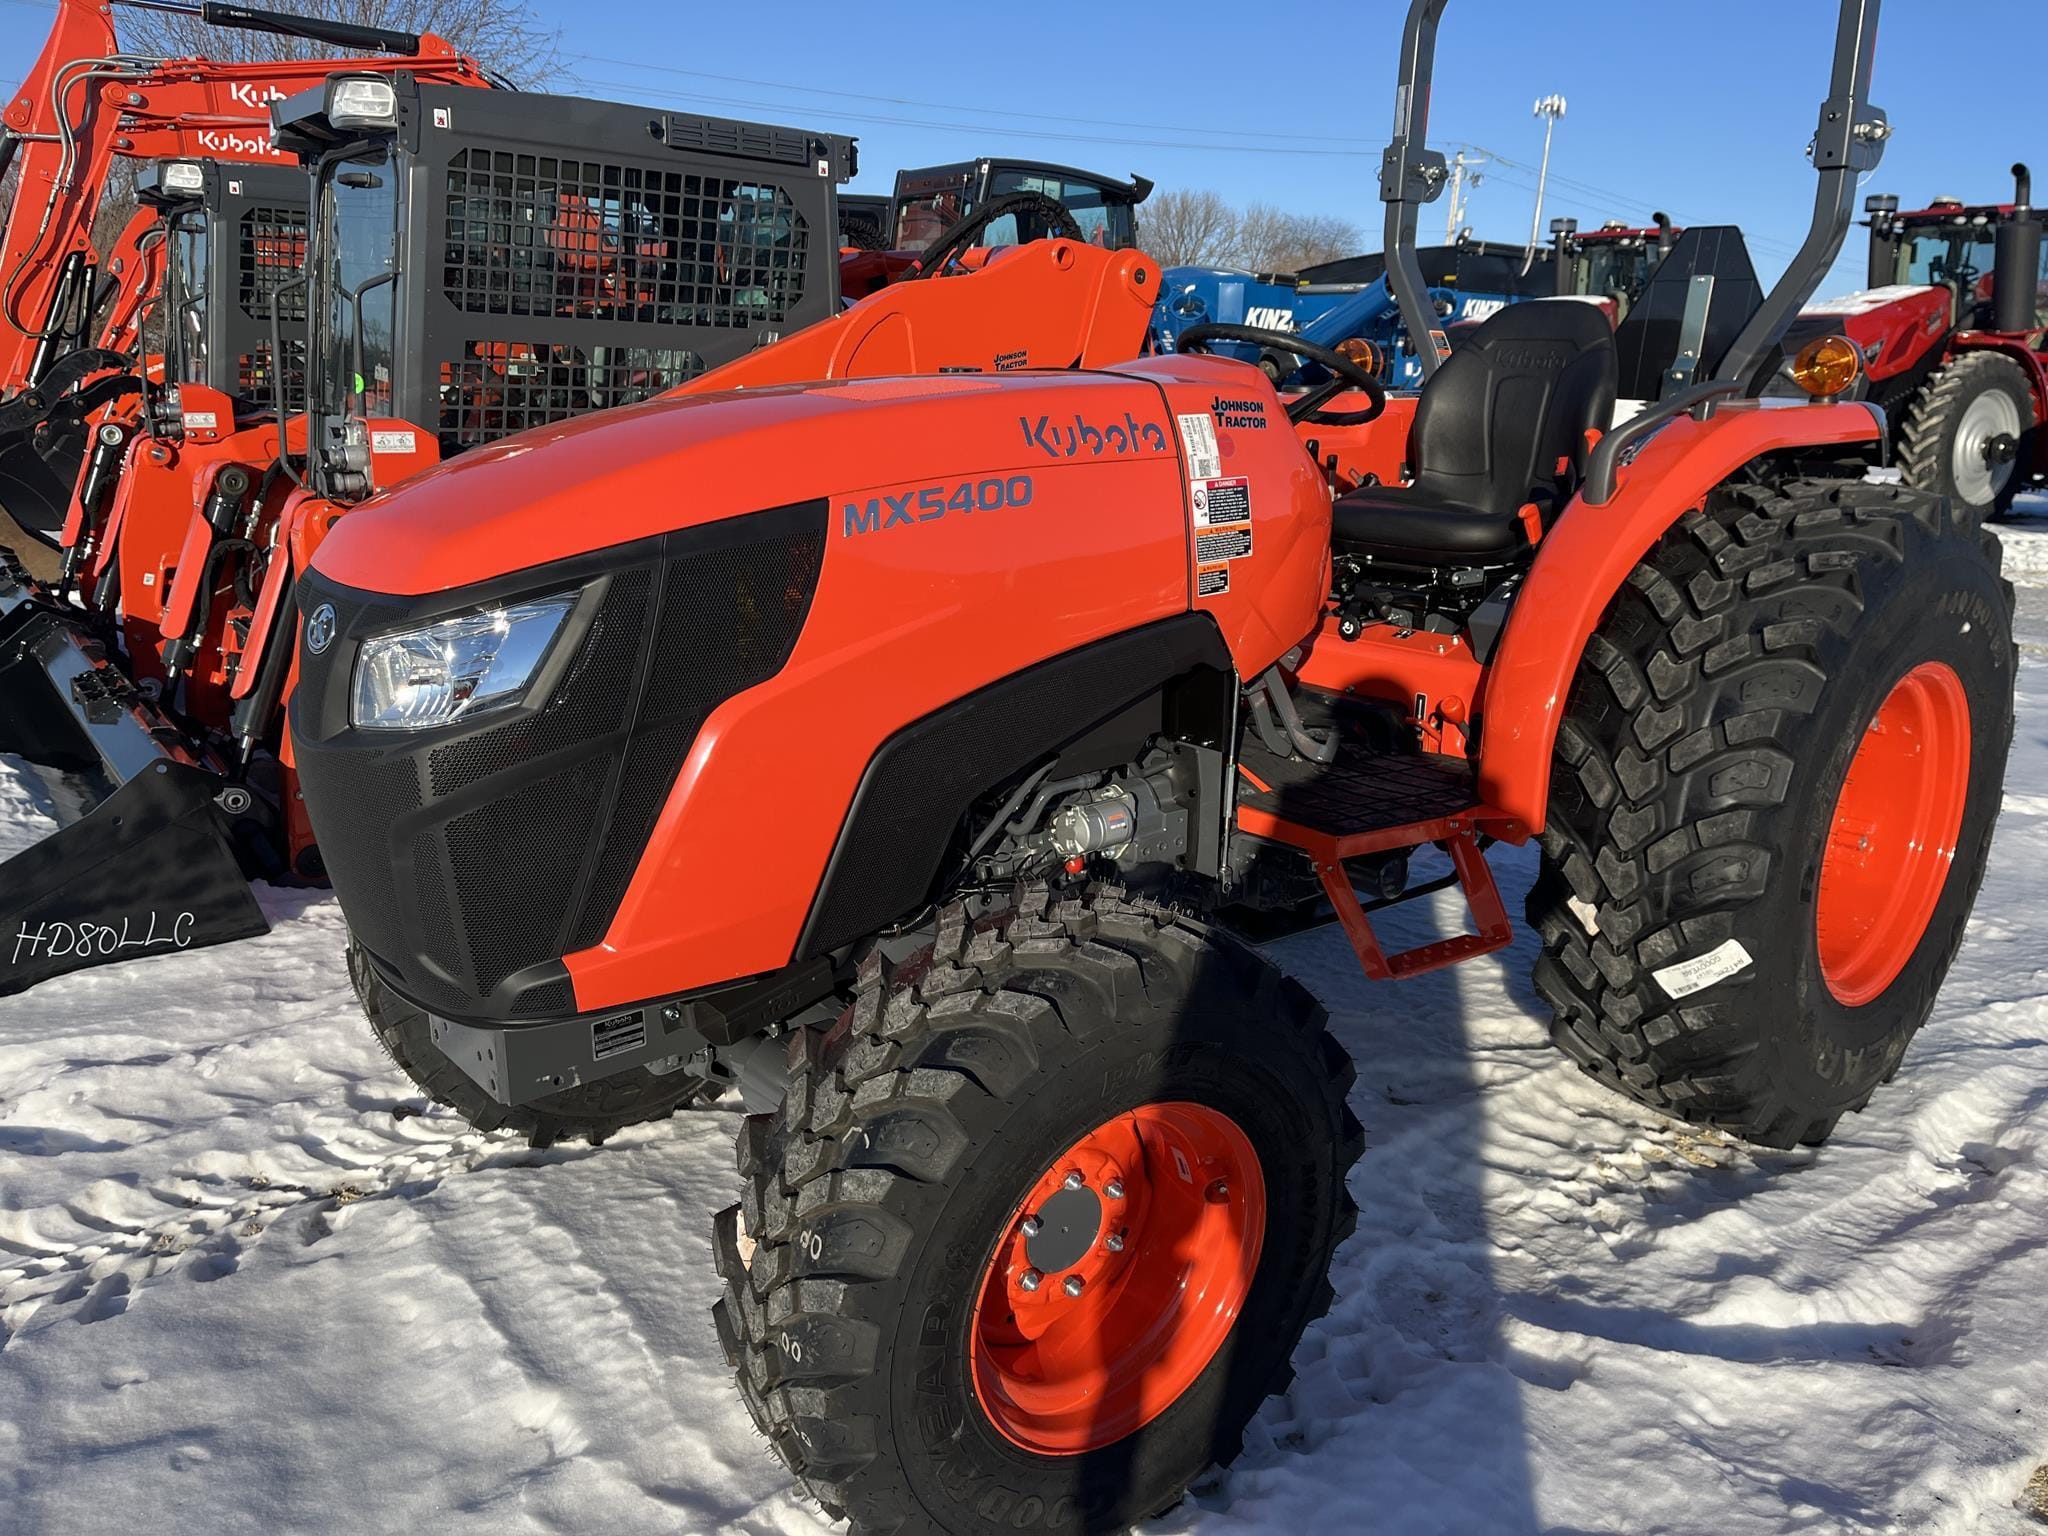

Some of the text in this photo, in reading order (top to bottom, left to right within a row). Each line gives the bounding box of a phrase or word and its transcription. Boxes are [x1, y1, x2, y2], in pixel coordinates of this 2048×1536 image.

[231, 82, 297, 108] Kub
[1244, 306, 1294, 332] KINZ
[1461, 298, 1506, 318] KINZ
[994, 350, 1027, 363] JOHNSON
[995, 359, 1028, 372] TRACTOR
[1211, 397, 1264, 413] JOHNSON
[1215, 412, 1267, 429] TRACTOR
[1019, 412, 1167, 458] Kubota
[843, 475, 1034, 539] MX5400
[12, 911, 195, 964] HD80LLC
